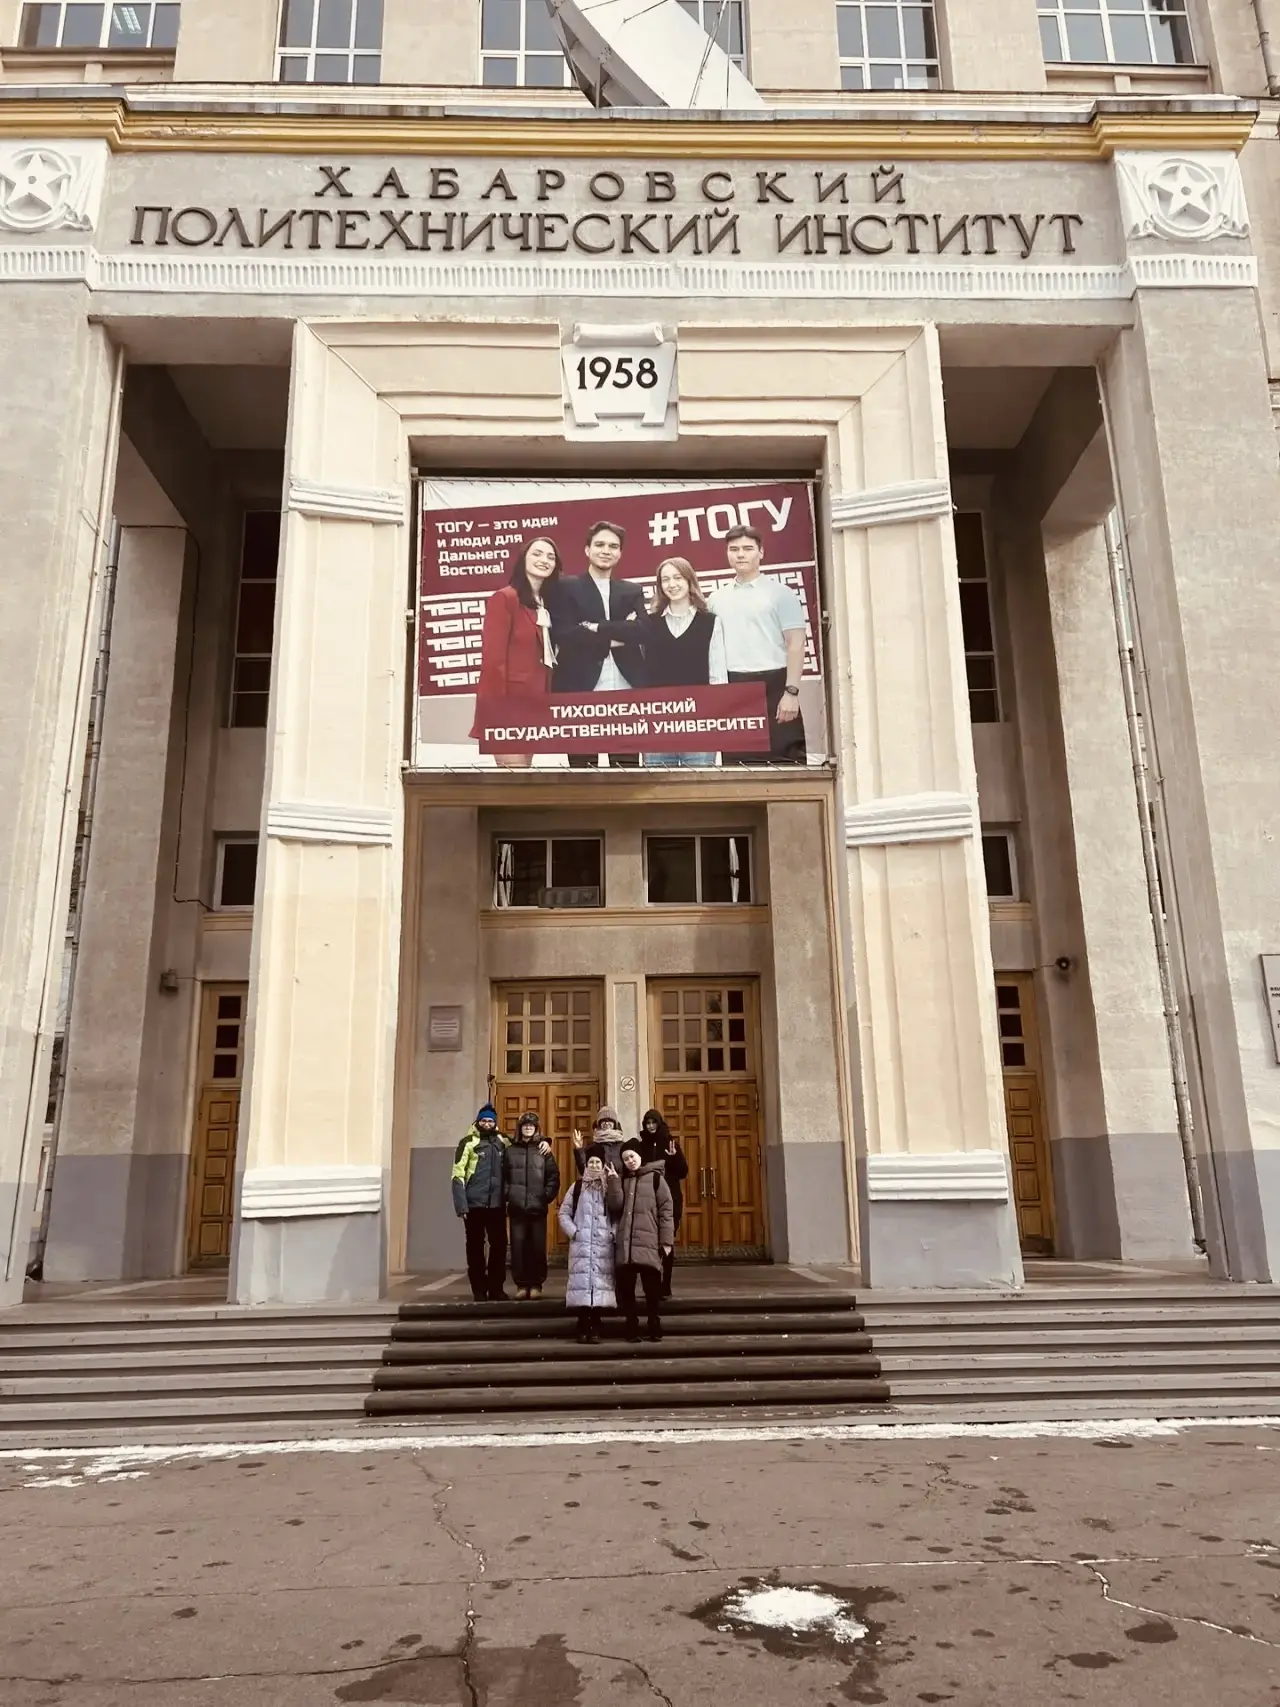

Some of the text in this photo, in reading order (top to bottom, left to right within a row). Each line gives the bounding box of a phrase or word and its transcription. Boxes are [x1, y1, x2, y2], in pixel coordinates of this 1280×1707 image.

[314, 164, 906, 204] ХАБАРОВСКИЙ
[130, 205, 1083, 258] ПОЛИТЕХНИЧЕСКИЙ ИНСТИТУТ
[576, 356, 659, 390] 1958
[435, 520, 474, 534] ТОГУ
[493, 519, 518, 530] это
[522, 516, 558, 530] идеи
[648, 497, 793, 547] #ТОГУ
[437, 533, 523, 548] и люди для
[438, 549, 510, 564] Дальнего
[439, 561, 505, 577] Востока!
[550, 697, 697, 719] ТИХООКЕАНСКИЙ
[484, 716, 766, 741] ГОСУДАРСТВЕННЫЙ УНИВЕРСИТЕТ
